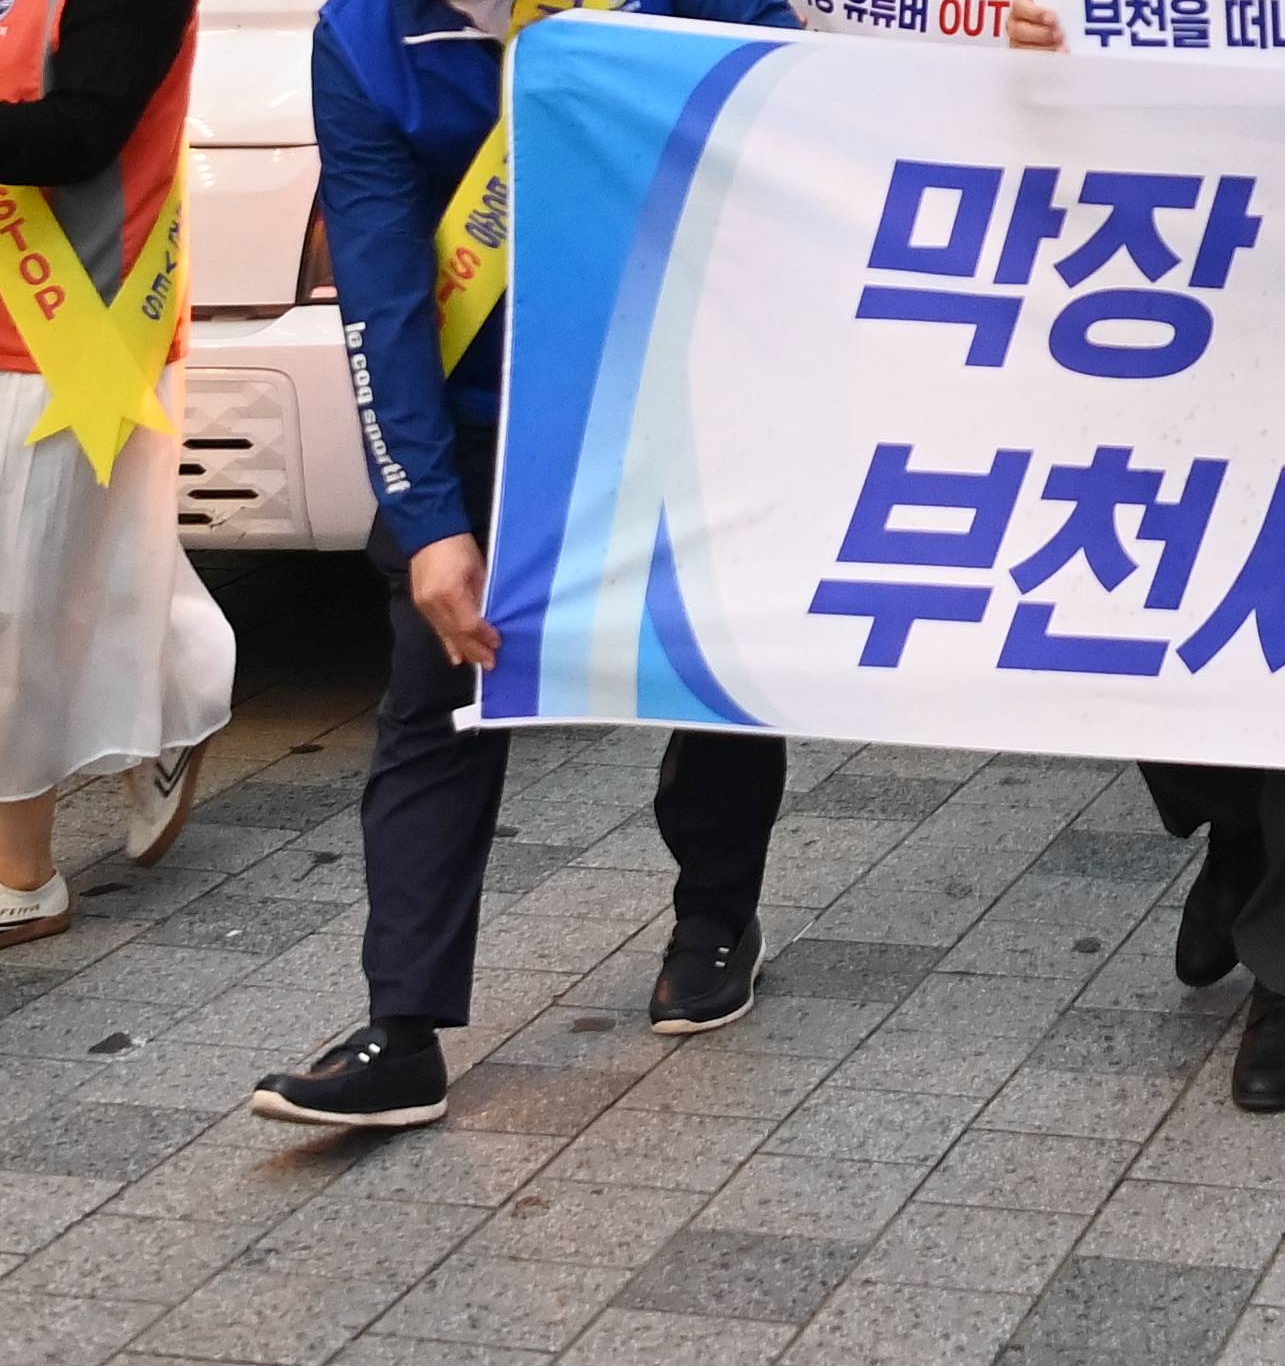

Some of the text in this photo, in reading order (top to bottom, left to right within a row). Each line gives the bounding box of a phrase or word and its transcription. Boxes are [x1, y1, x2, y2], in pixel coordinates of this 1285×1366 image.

[854, 157, 1261, 381] 막장
[345, 321, 412, 495] le coq sportif
